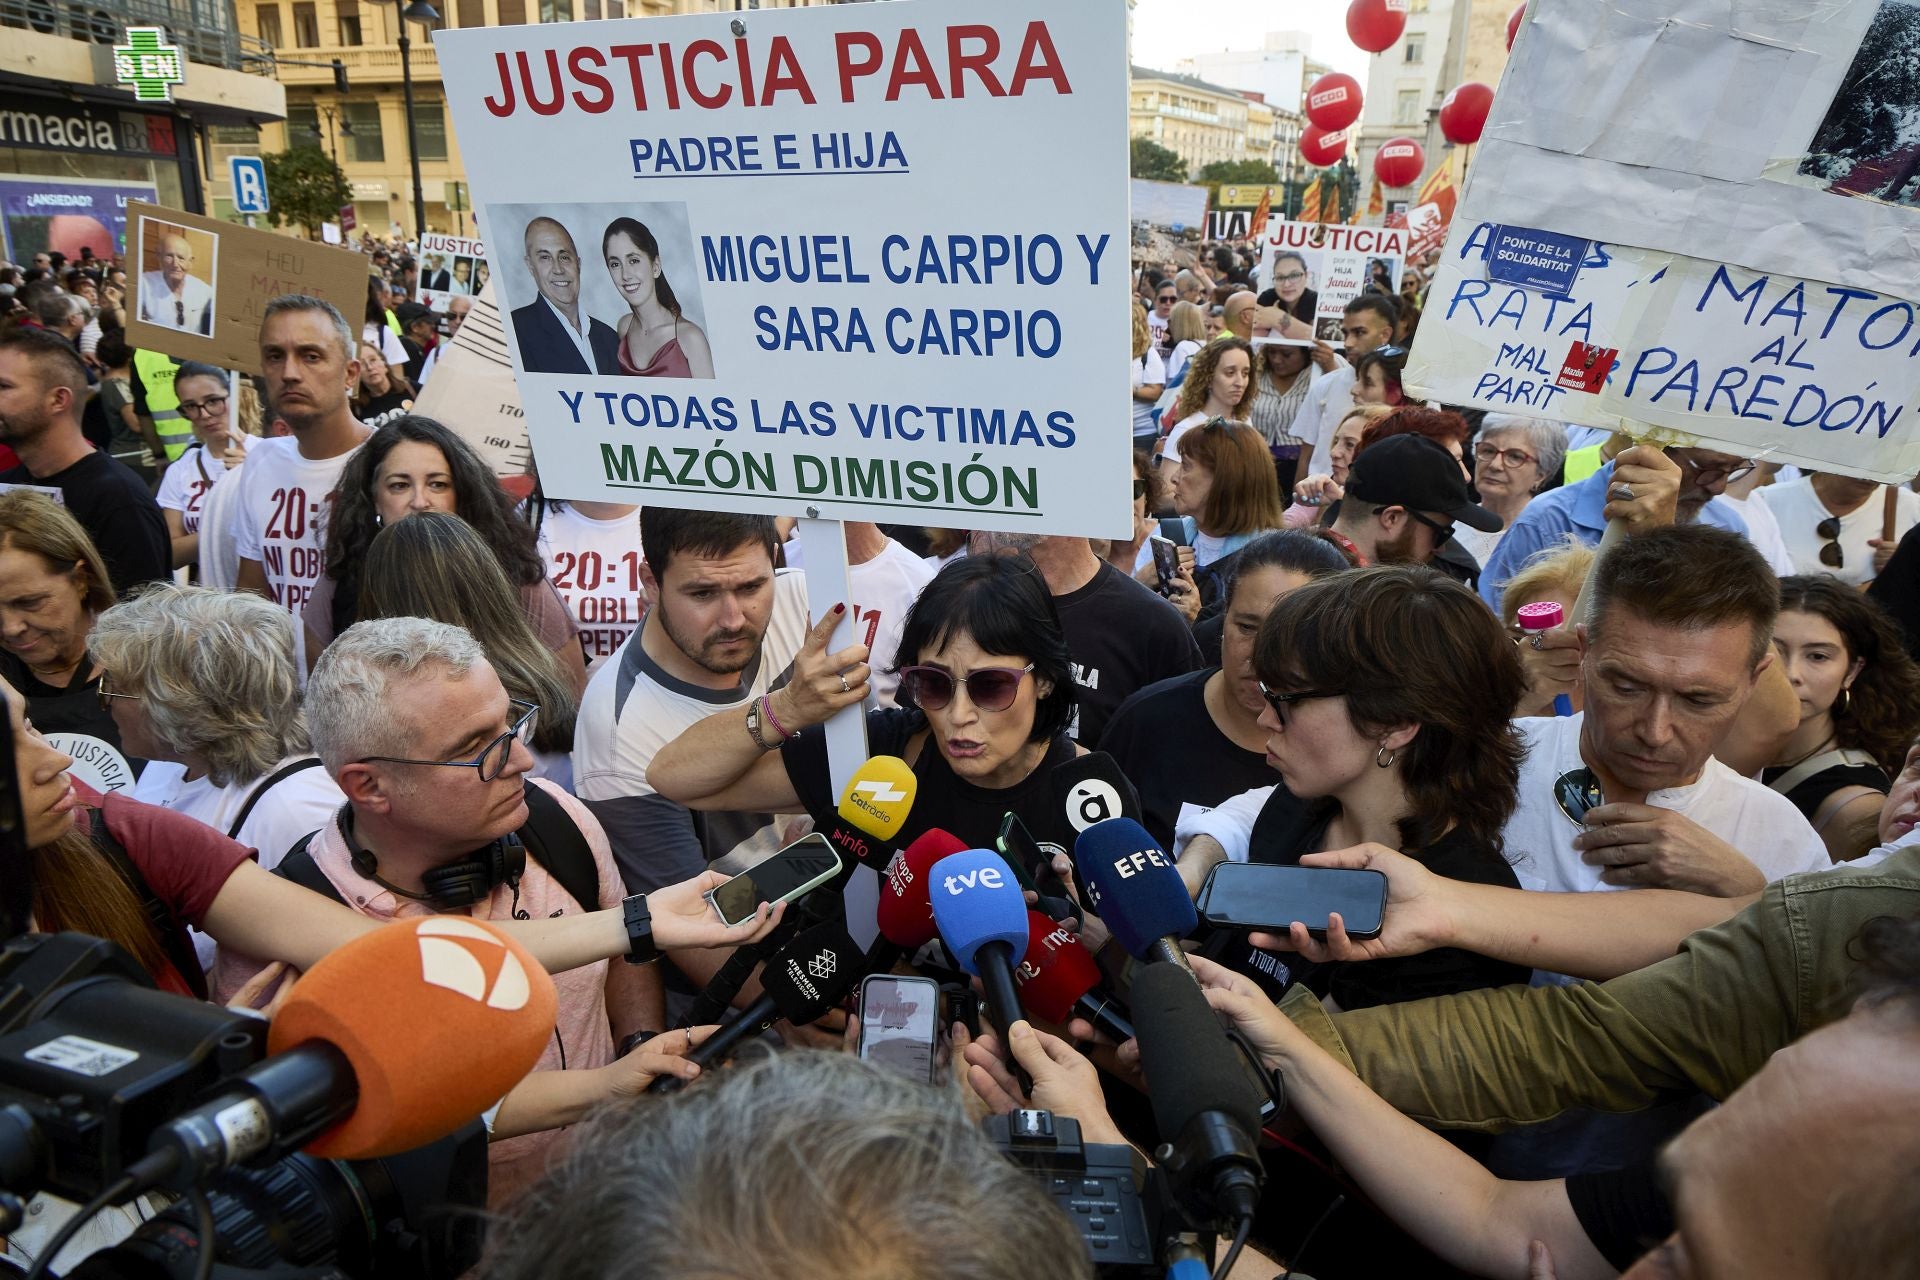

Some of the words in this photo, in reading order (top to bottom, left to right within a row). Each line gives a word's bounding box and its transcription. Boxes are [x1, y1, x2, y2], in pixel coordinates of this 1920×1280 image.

[484, 36, 816, 118] JUSTICIA
[835, 21, 1072, 103] PARA
[630, 137, 763, 172] PADRE
[773, 135, 801, 169] E
[812, 132, 908, 168] HIJA
[701, 234, 870, 283] MIGUEL
[881, 234, 1063, 285] CARPIO
[1076, 233, 1110, 285] Y
[1497, 249, 1572, 273] SOLIDARITAT
[1502, 235, 1537, 251] PONT
[1536, 242, 1553, 254] DE
[1554, 246, 1571, 259] LA
[1446, 279, 1593, 342] RATA
[754, 306, 875, 355] SARA
[885, 307, 1062, 359] CARPIO
[1494, 342, 1551, 375] MAL
[1750, 335, 1815, 371] AL
[1558, 377, 1586, 389] Dimissió
[1563, 366, 1584, 378] Mazón
[1624, 346, 1903, 439] PAREDÓN
[499, 403, 524, 418] 170
[558, 390, 584, 422] Y
[594, 392, 738, 432] TODAS
[751, 399, 837, 437] LAS
[848, 403, 1076, 449] VICTIMAS
[484, 436, 510, 449] 160
[600, 440, 777, 493] MAZÓN
[793, 452, 1039, 509] DIMISIÓN
[850, 792, 891, 824] Catràdio
[841, 830, 868, 857] info
[944, 867, 1004, 895] tve
[787, 959, 820, 1000] ATRESMEDIA
